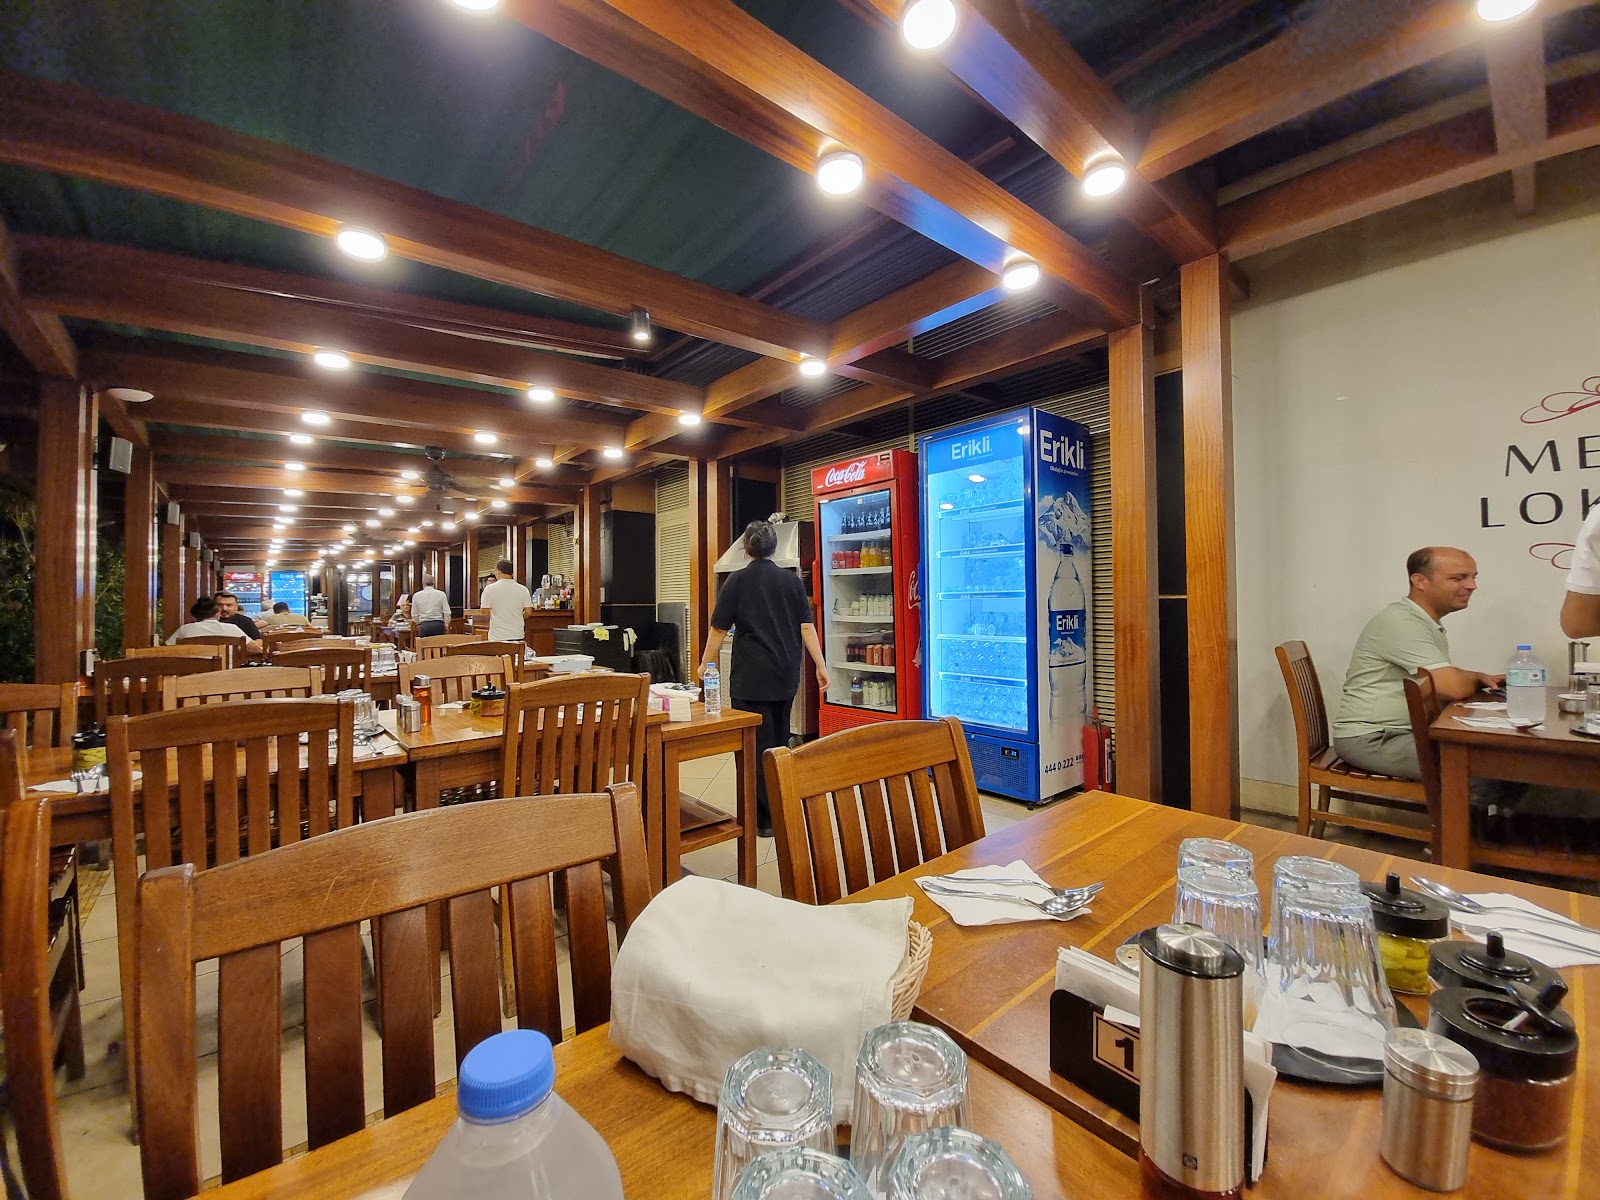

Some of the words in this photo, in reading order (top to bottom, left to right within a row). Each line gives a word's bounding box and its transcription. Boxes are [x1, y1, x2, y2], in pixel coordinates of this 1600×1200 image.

[951, 435, 991, 461] Erikli
[1040, 429, 1085, 470] Erikli
[825, 460, 867, 488] Coca-Cola
[1056, 614, 1080, 631] Erikli
[1044, 763, 1056, 774] 444
[1057, 761, 1062, 770] 0
[1062, 757, 1074, 769] 222
